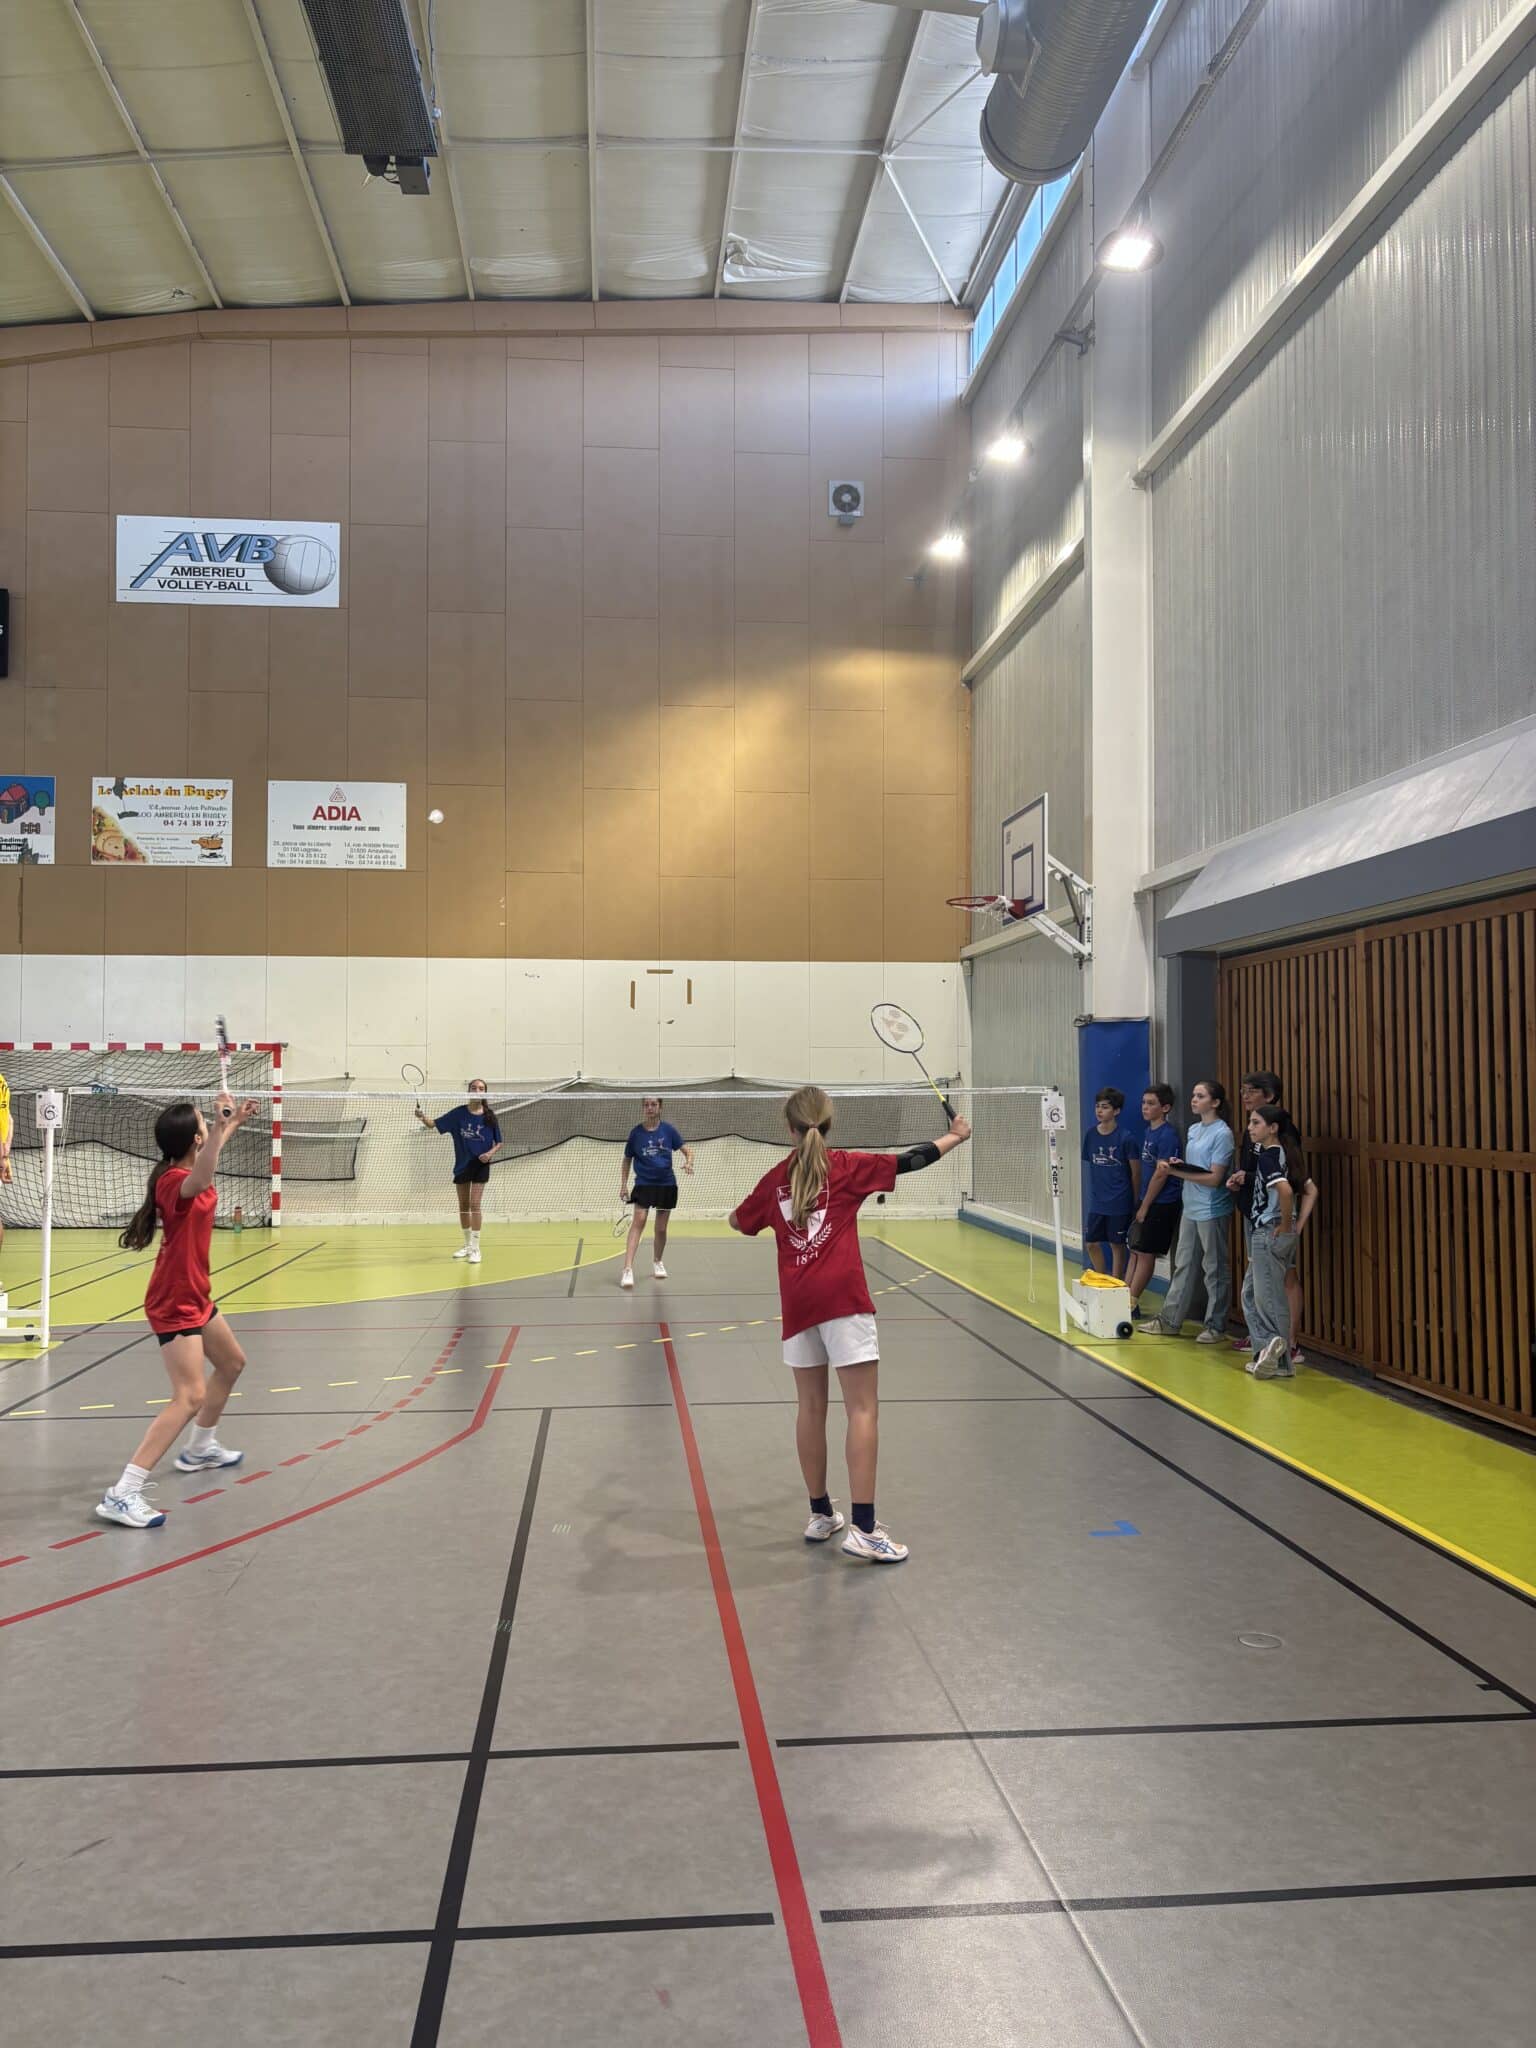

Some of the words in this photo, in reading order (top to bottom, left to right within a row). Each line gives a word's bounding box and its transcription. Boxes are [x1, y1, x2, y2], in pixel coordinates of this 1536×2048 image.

[130, 532, 278, 588] AVB
[170, 567, 246, 578] AMBERIEU
[157, 579, 253, 591] VOLLEY-BALL
[98, 785, 113, 796] Le
[184, 785, 228, 800] Bugey
[312, 805, 362, 821] ADIA
[44, 1105, 56, 1121] 6
[1050, 1107, 1060, 1123] 6
